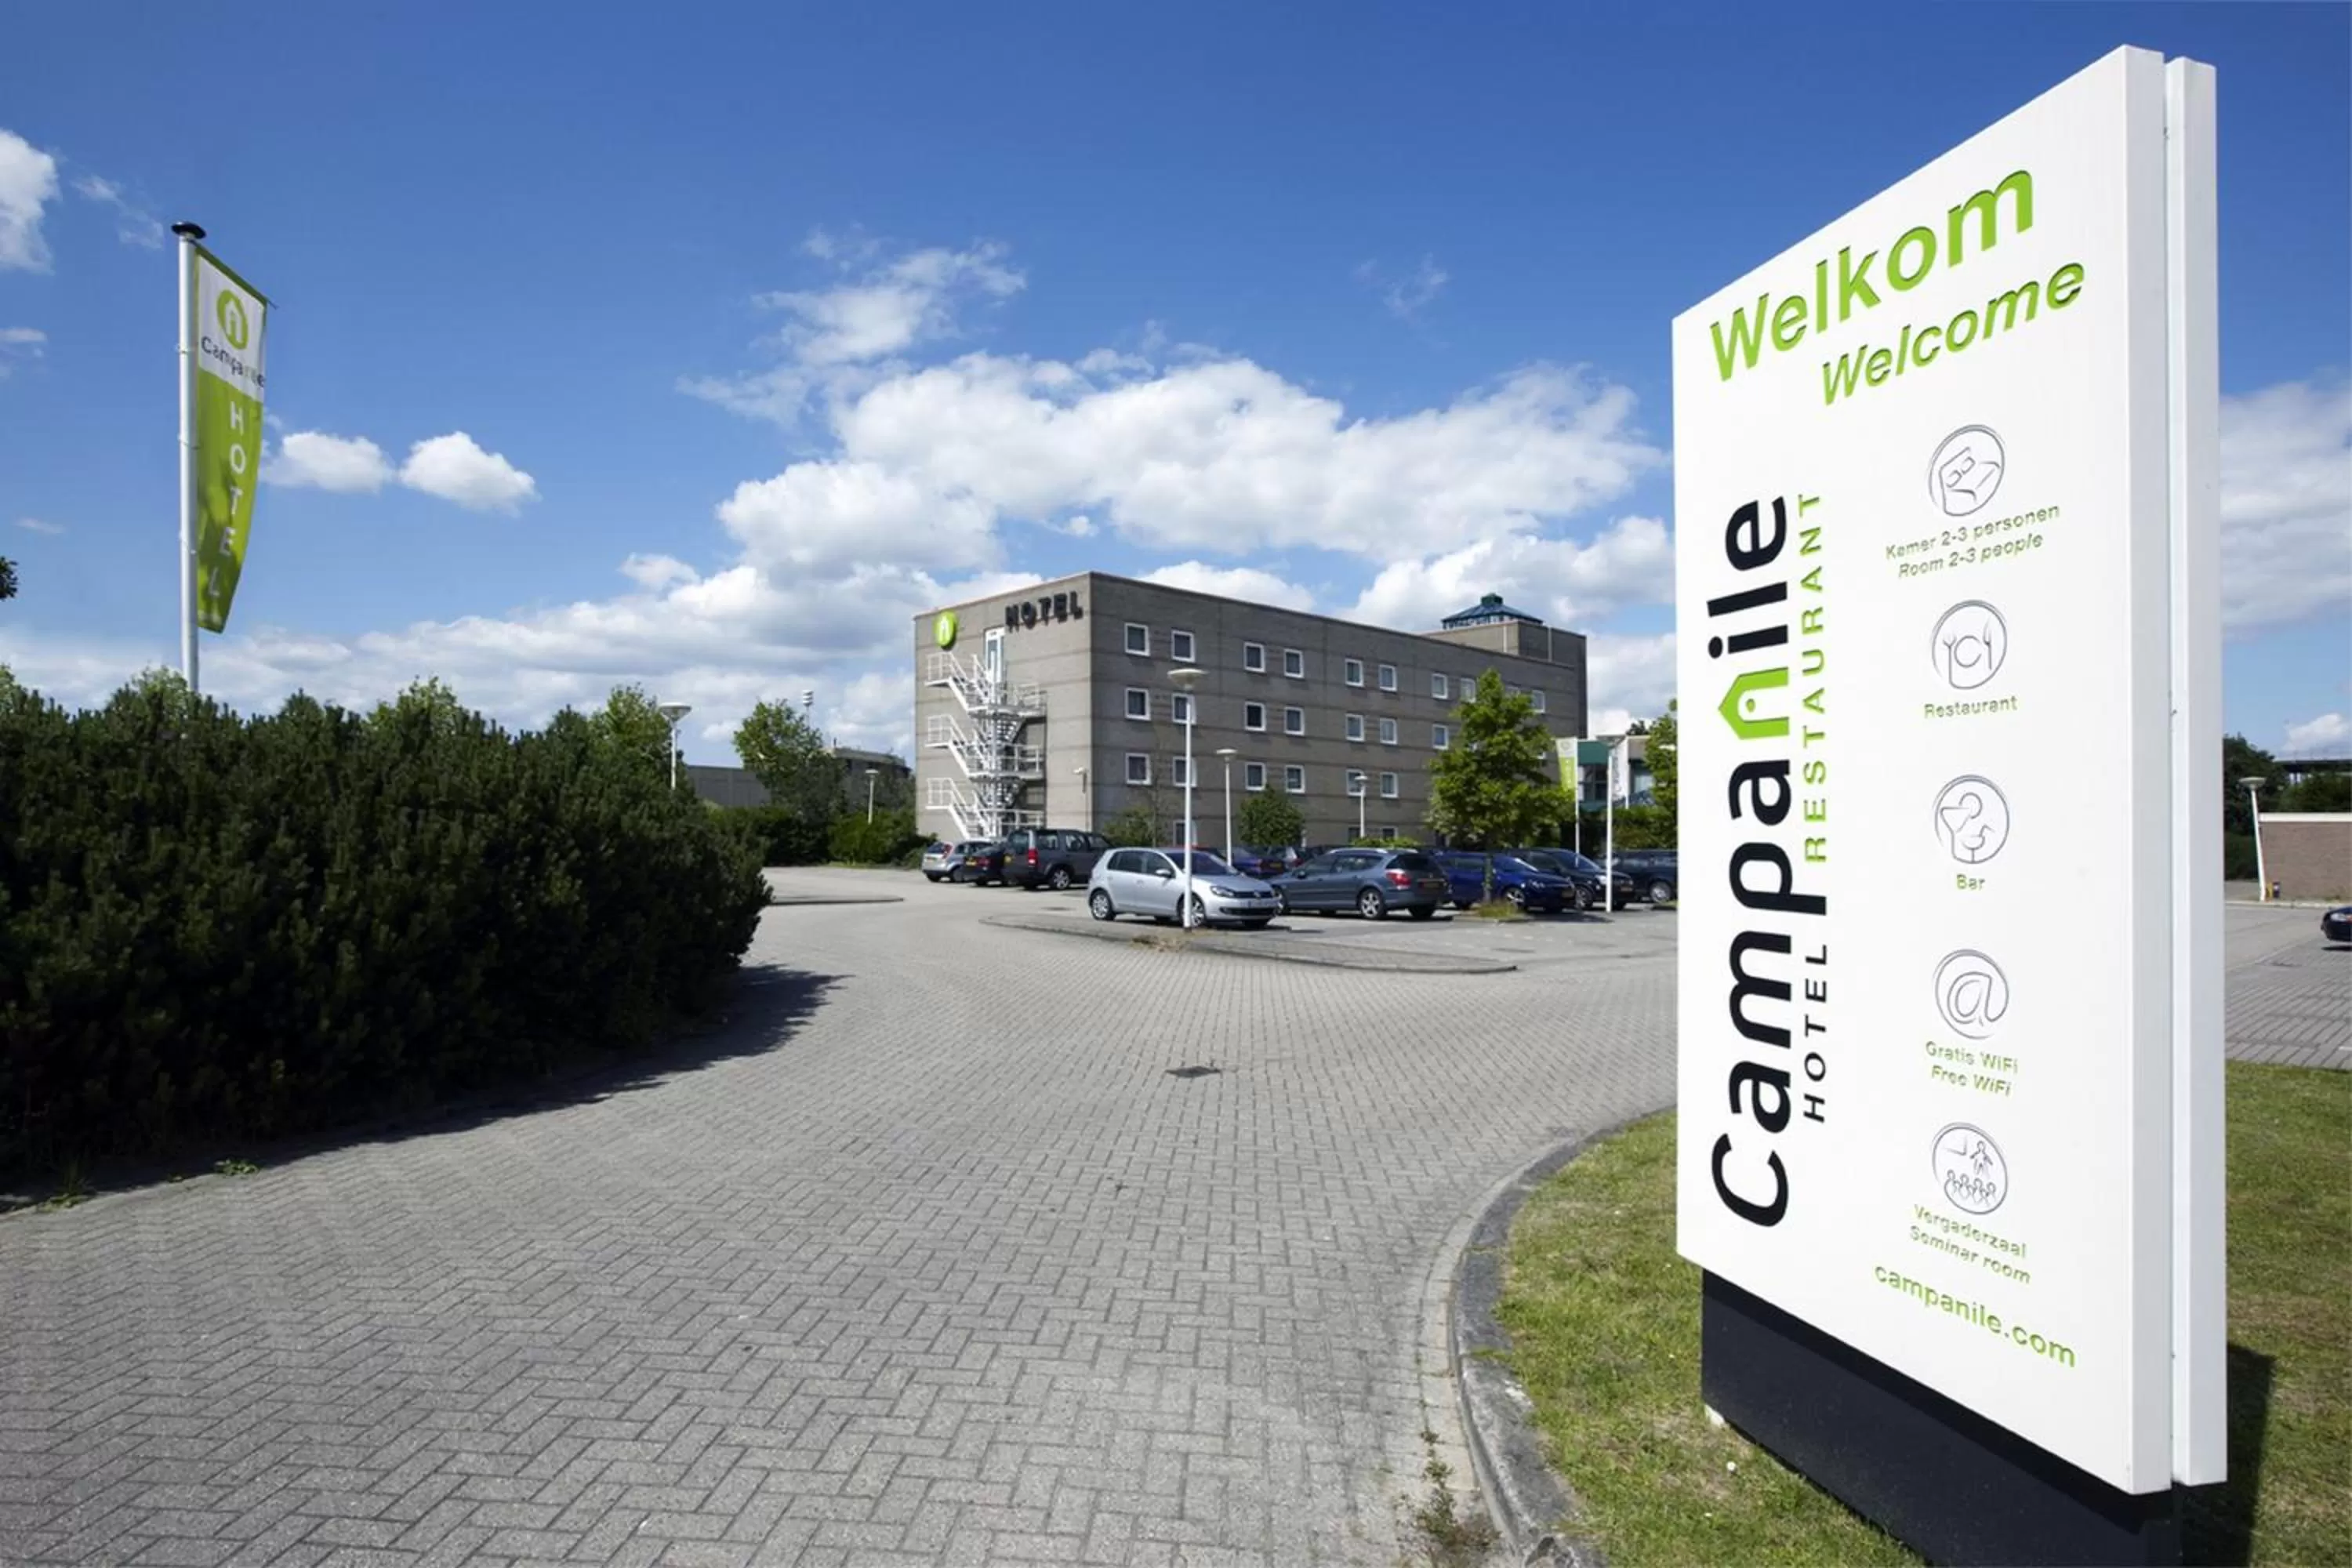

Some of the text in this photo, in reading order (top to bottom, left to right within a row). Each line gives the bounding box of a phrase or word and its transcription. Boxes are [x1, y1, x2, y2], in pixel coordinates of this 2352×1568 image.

[1710, 169, 2034, 383] Welkom
[1821, 262, 2085, 406] Welcome
[201, 336, 265, 388] Campae
[208, 401, 247, 597] HOTEL
[1886, 506, 2060, 560] Kamer 2-3 personen
[1898, 532, 2043, 579] Room 2-3 people
[1004, 591, 1083, 633] HOTEL
[1923, 695, 2019, 719] Restaurant
[1798, 494, 1828, 1123] HOTEL RESTAURANT
[1707, 495, 1827, 1228] Campanile
[1956, 873, 1985, 890] Bar
[1926, 1040, 2019, 1075] Gratis WiFi
[1931, 1064, 2012, 1098] Free WiFi
[1909, 1225, 2031, 1284] Seminar room
[1914, 1204, 2027, 1258] Vergaderzaal
[1875, 1265, 2076, 1368] campanile.com
